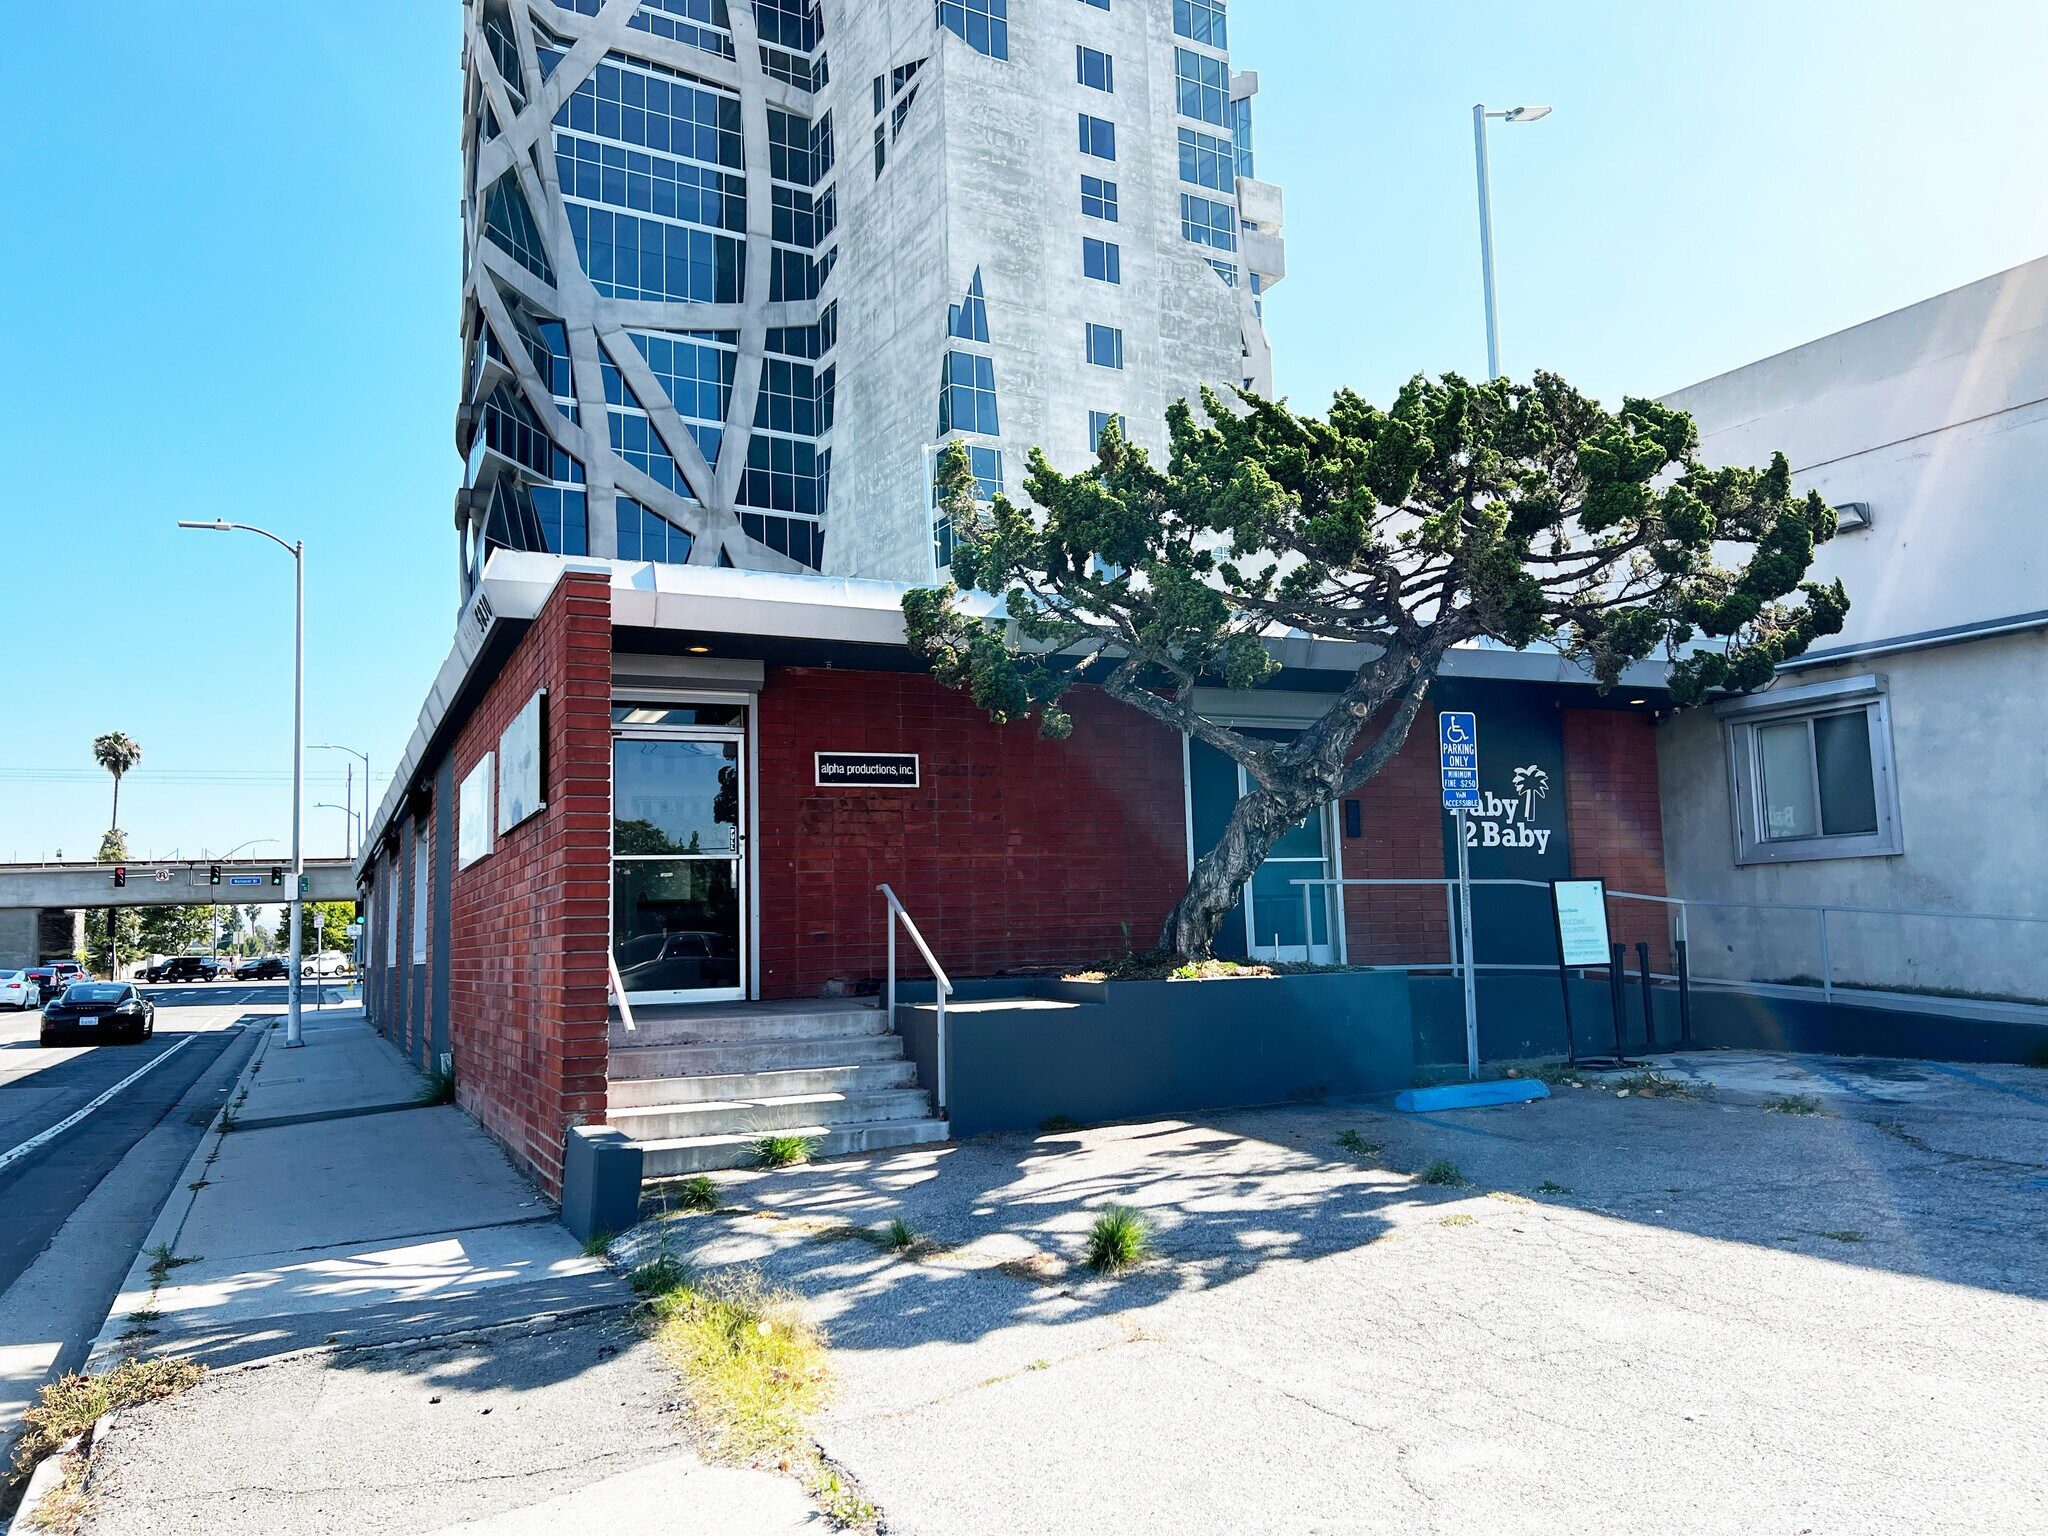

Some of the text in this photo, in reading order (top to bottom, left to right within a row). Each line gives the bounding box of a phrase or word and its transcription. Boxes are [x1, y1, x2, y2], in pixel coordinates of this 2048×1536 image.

[1443, 743, 1475, 755] PARKING
[1449, 755, 1469, 767] ONLY
[820, 763, 914, 776] alpha productions, inc.
[1447, 770, 1472, 779] MINIMUM
[1444, 779, 1476, 788] FINE $250
[1455, 791, 1467, 799] VAN
[1445, 799, 1479, 807] ACCESSIBLE
